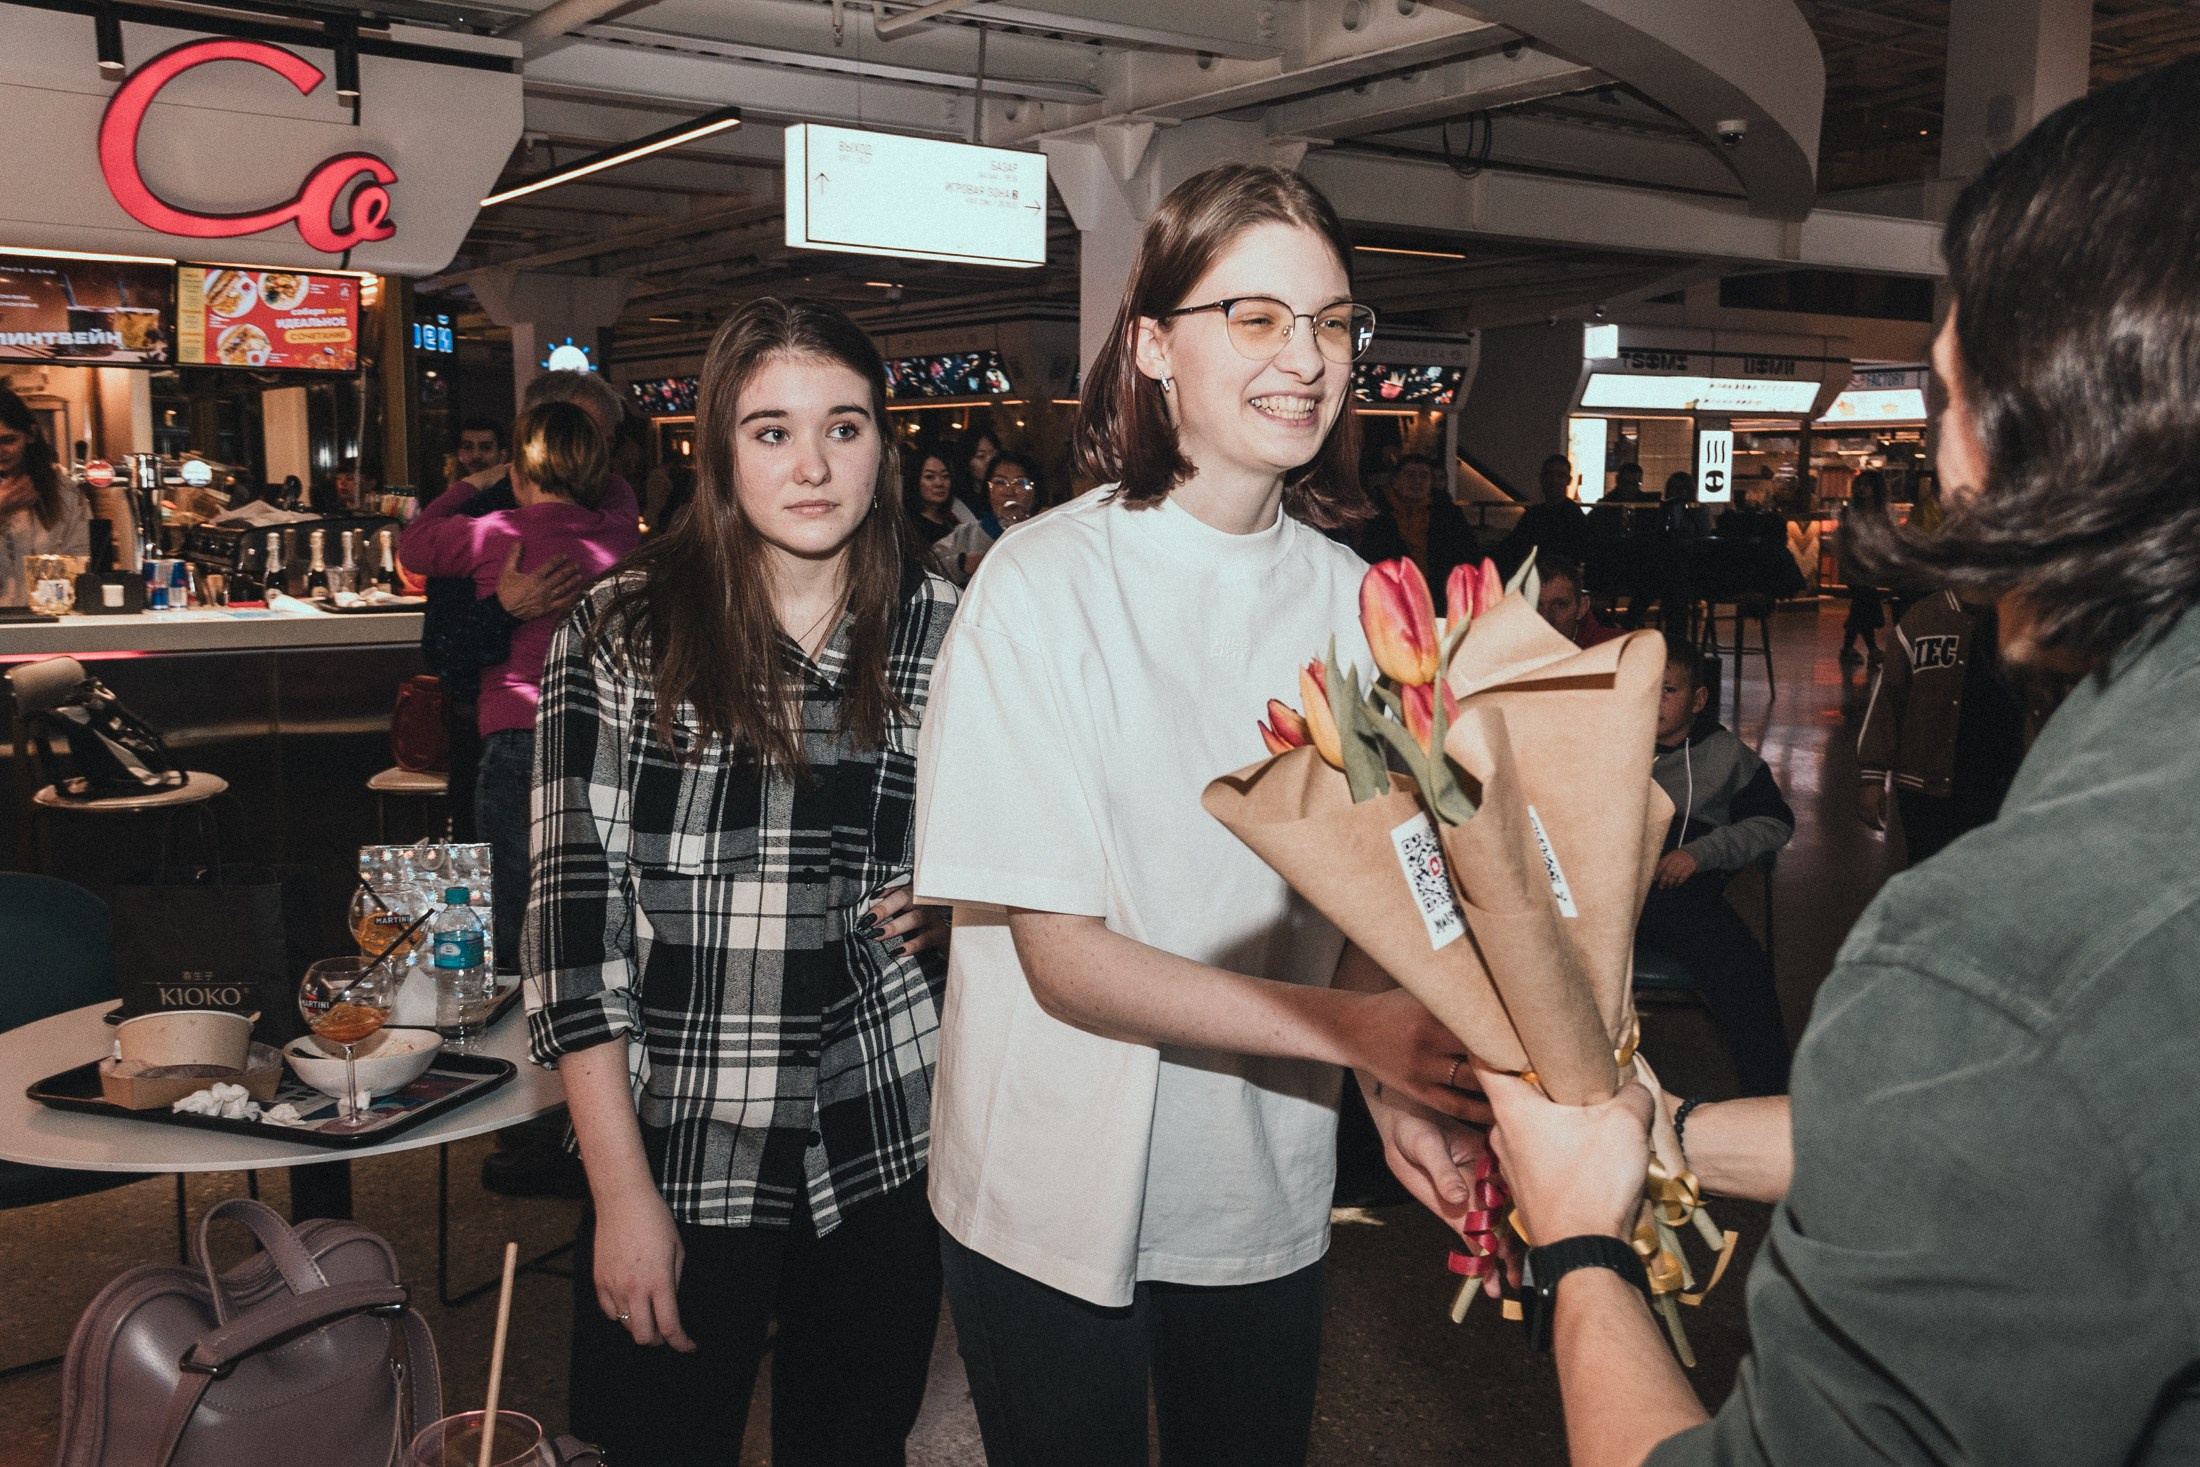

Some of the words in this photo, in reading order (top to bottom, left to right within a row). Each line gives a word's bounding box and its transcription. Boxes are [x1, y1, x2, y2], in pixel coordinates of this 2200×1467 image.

[275, 316, 347, 330] ИДЕАЛЬНОЕ
[1867, 371, 1906, 387] FACTORY
[375, 915, 410, 924] MARTINI
[160, 987, 241, 1006] KIOKO
